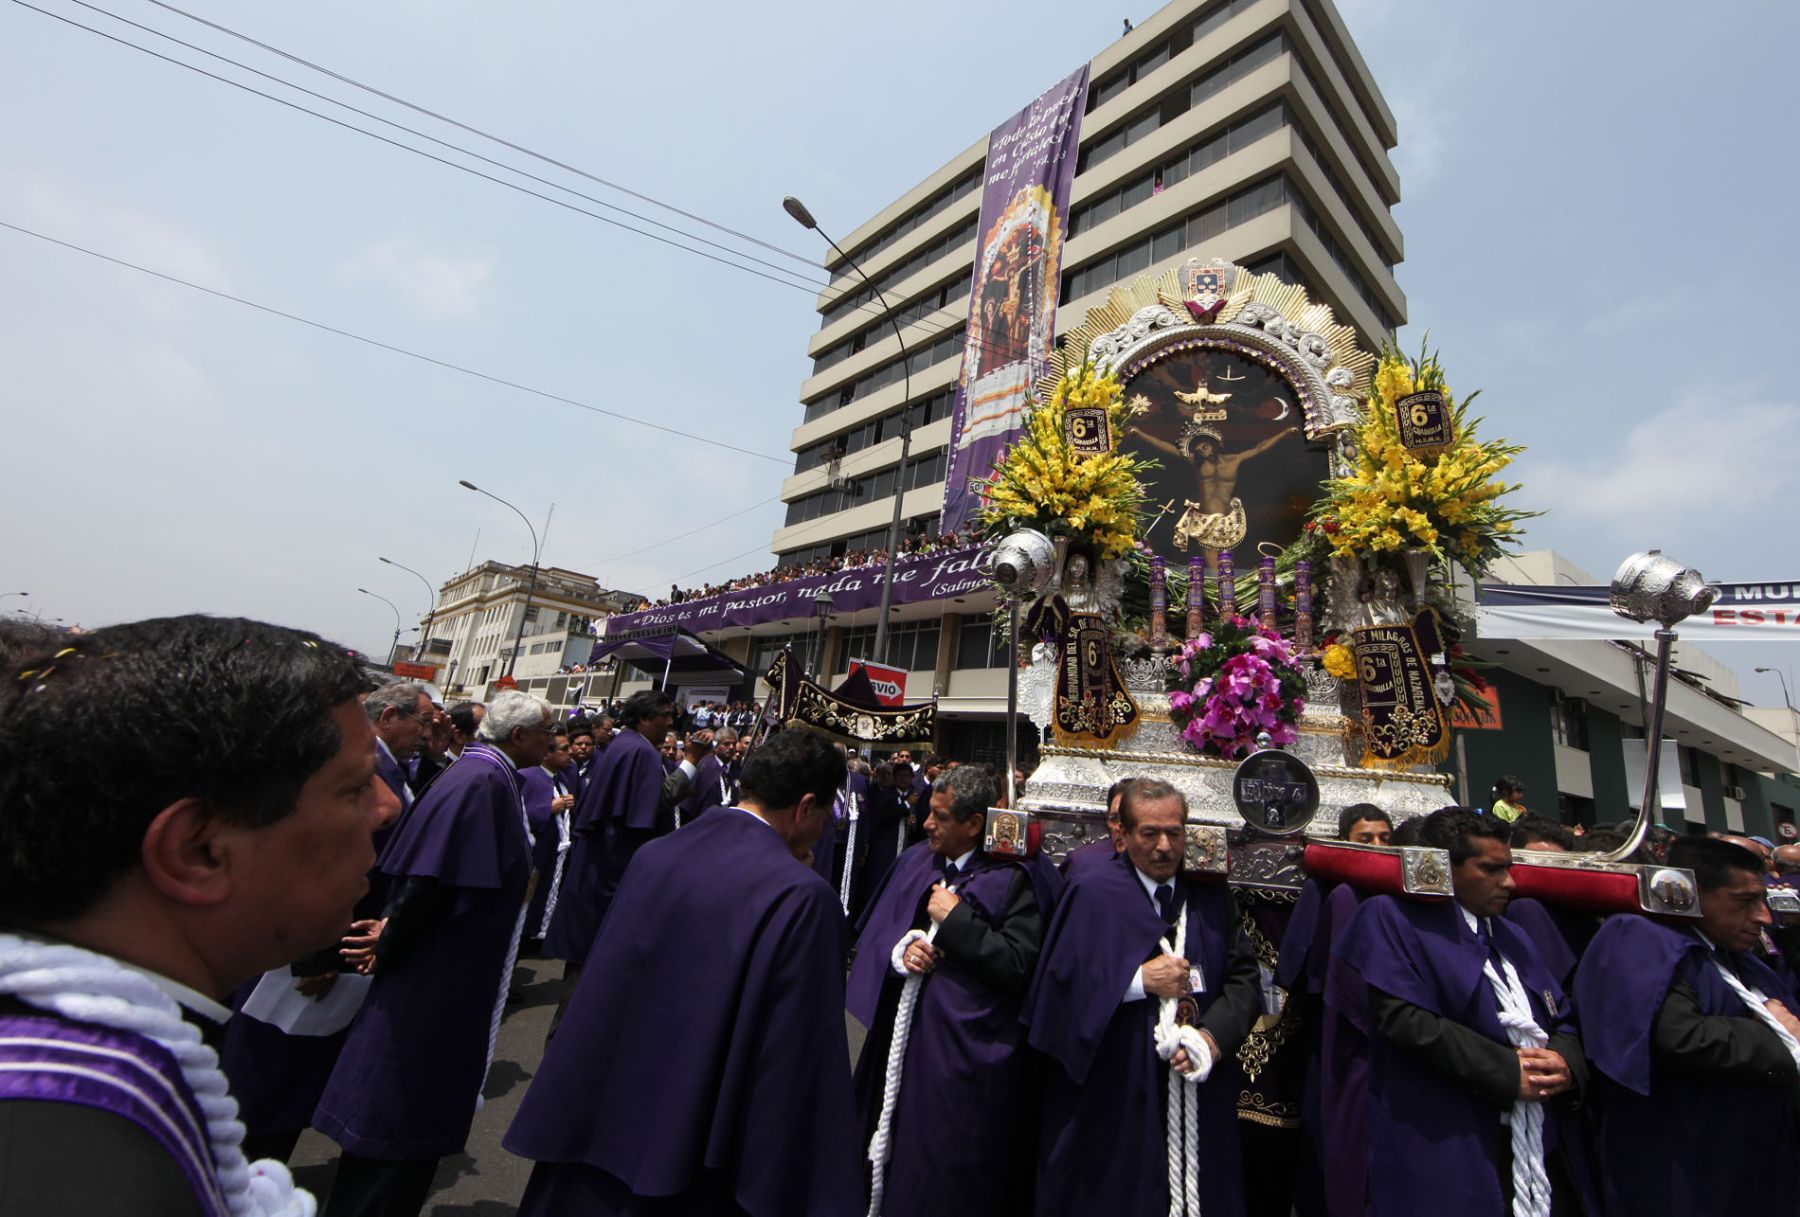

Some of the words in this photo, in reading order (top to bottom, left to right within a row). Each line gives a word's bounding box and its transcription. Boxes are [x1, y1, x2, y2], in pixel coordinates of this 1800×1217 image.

[992, 153, 1007, 168] en
[988, 169, 1009, 186] me
[678, 610, 692, 621] es
[699, 603, 719, 617] mi
[723, 592, 787, 618] pastor,
[798, 575, 863, 599] nada
[920, 549, 993, 587] falt
[1370, 630, 1413, 654] MILAGROS
[1405, 656, 1418, 668] DE
[871, 681, 897, 695] SVIO
[1408, 670, 1427, 716] NAZARENAS
